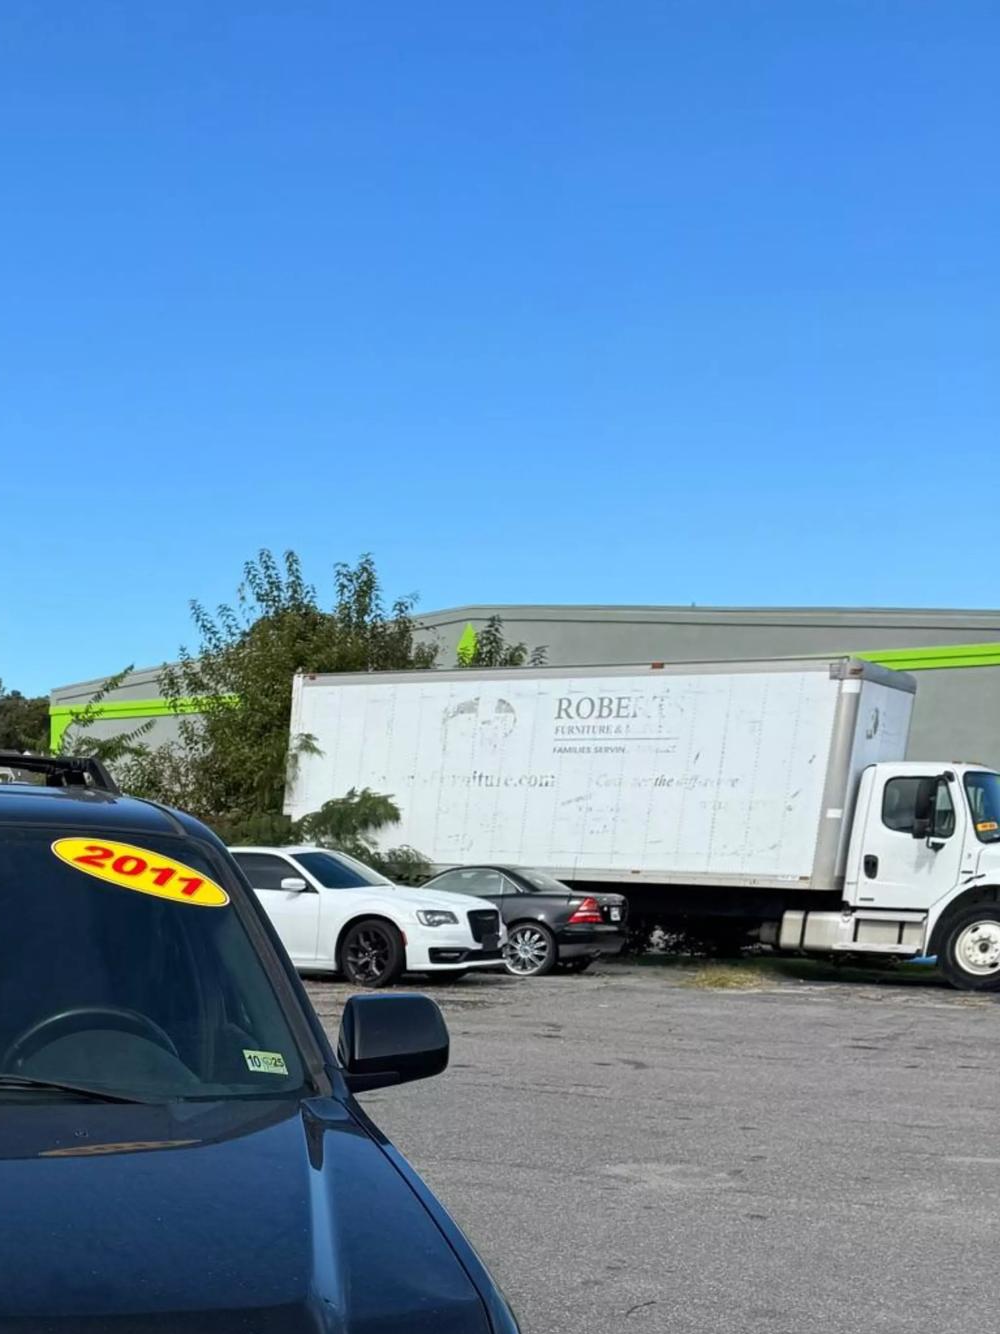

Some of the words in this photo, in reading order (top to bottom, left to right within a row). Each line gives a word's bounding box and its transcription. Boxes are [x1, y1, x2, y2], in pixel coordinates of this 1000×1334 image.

[594, 746, 627, 754] SERVIN
[73, 845, 204, 896] 2011
[248, 1054, 262, 1068] 10
